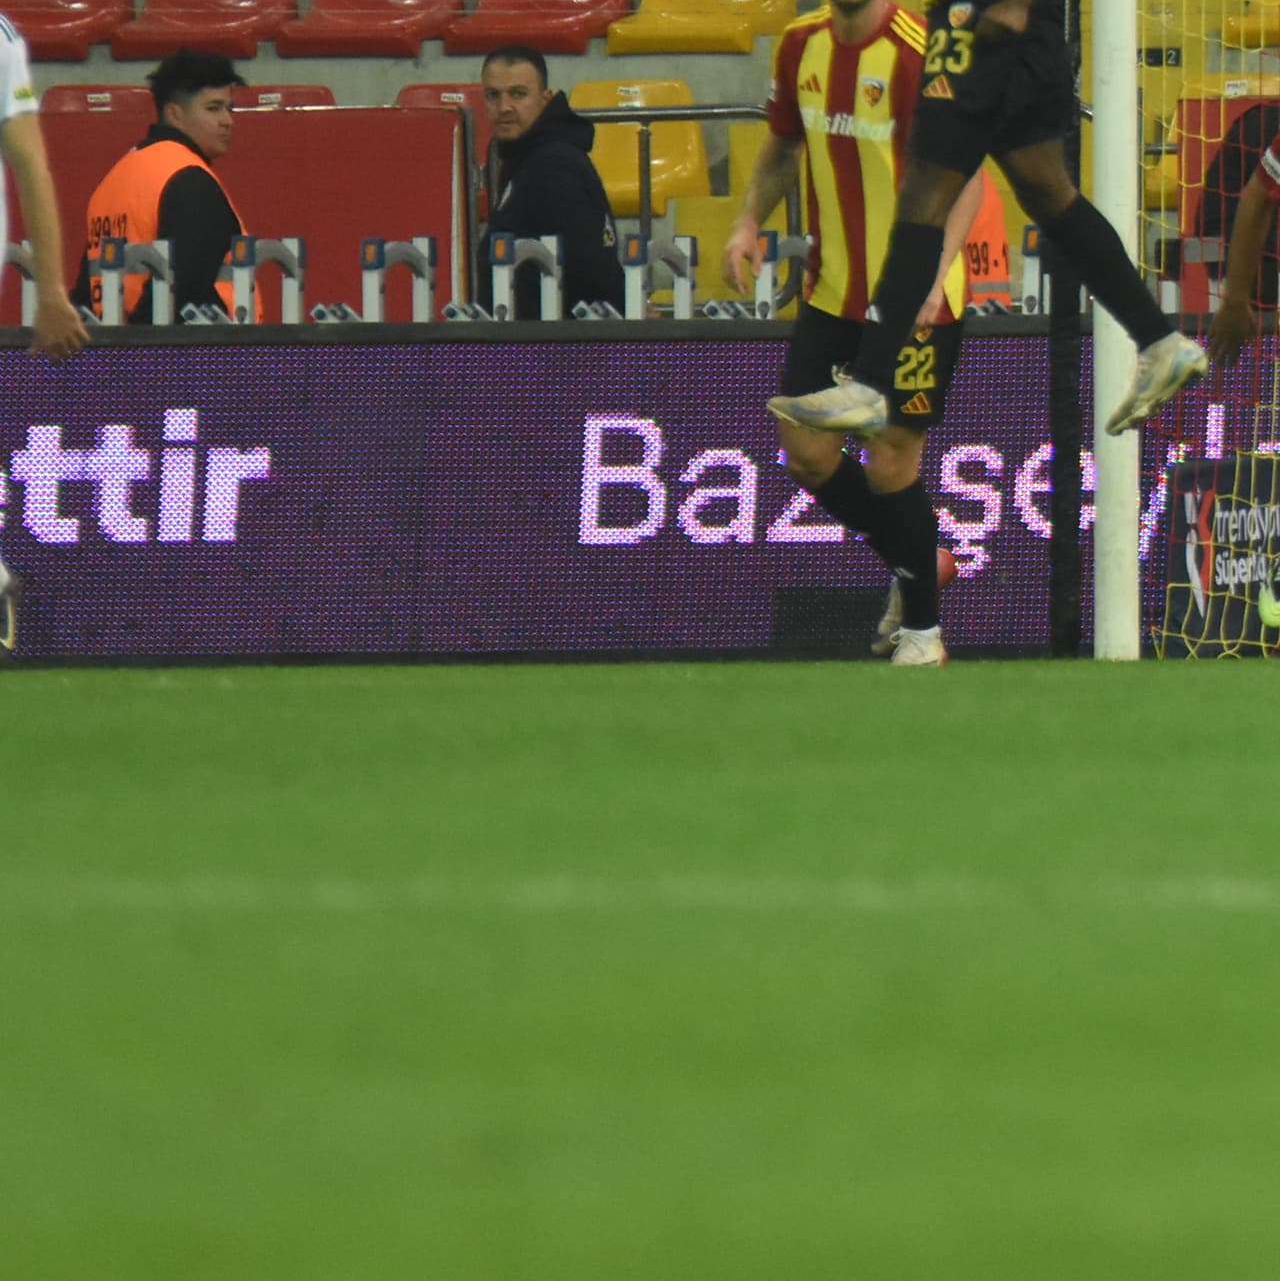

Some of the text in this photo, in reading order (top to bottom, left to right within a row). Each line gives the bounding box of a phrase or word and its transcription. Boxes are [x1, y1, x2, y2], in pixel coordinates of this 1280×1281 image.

[925, 28, 974, 74] 23
[1167, 50, 1178, 65] 2
[894, 345, 937, 390] 22
[0, 408, 271, 544] ttir
[577, 412, 868, 545] Baz
